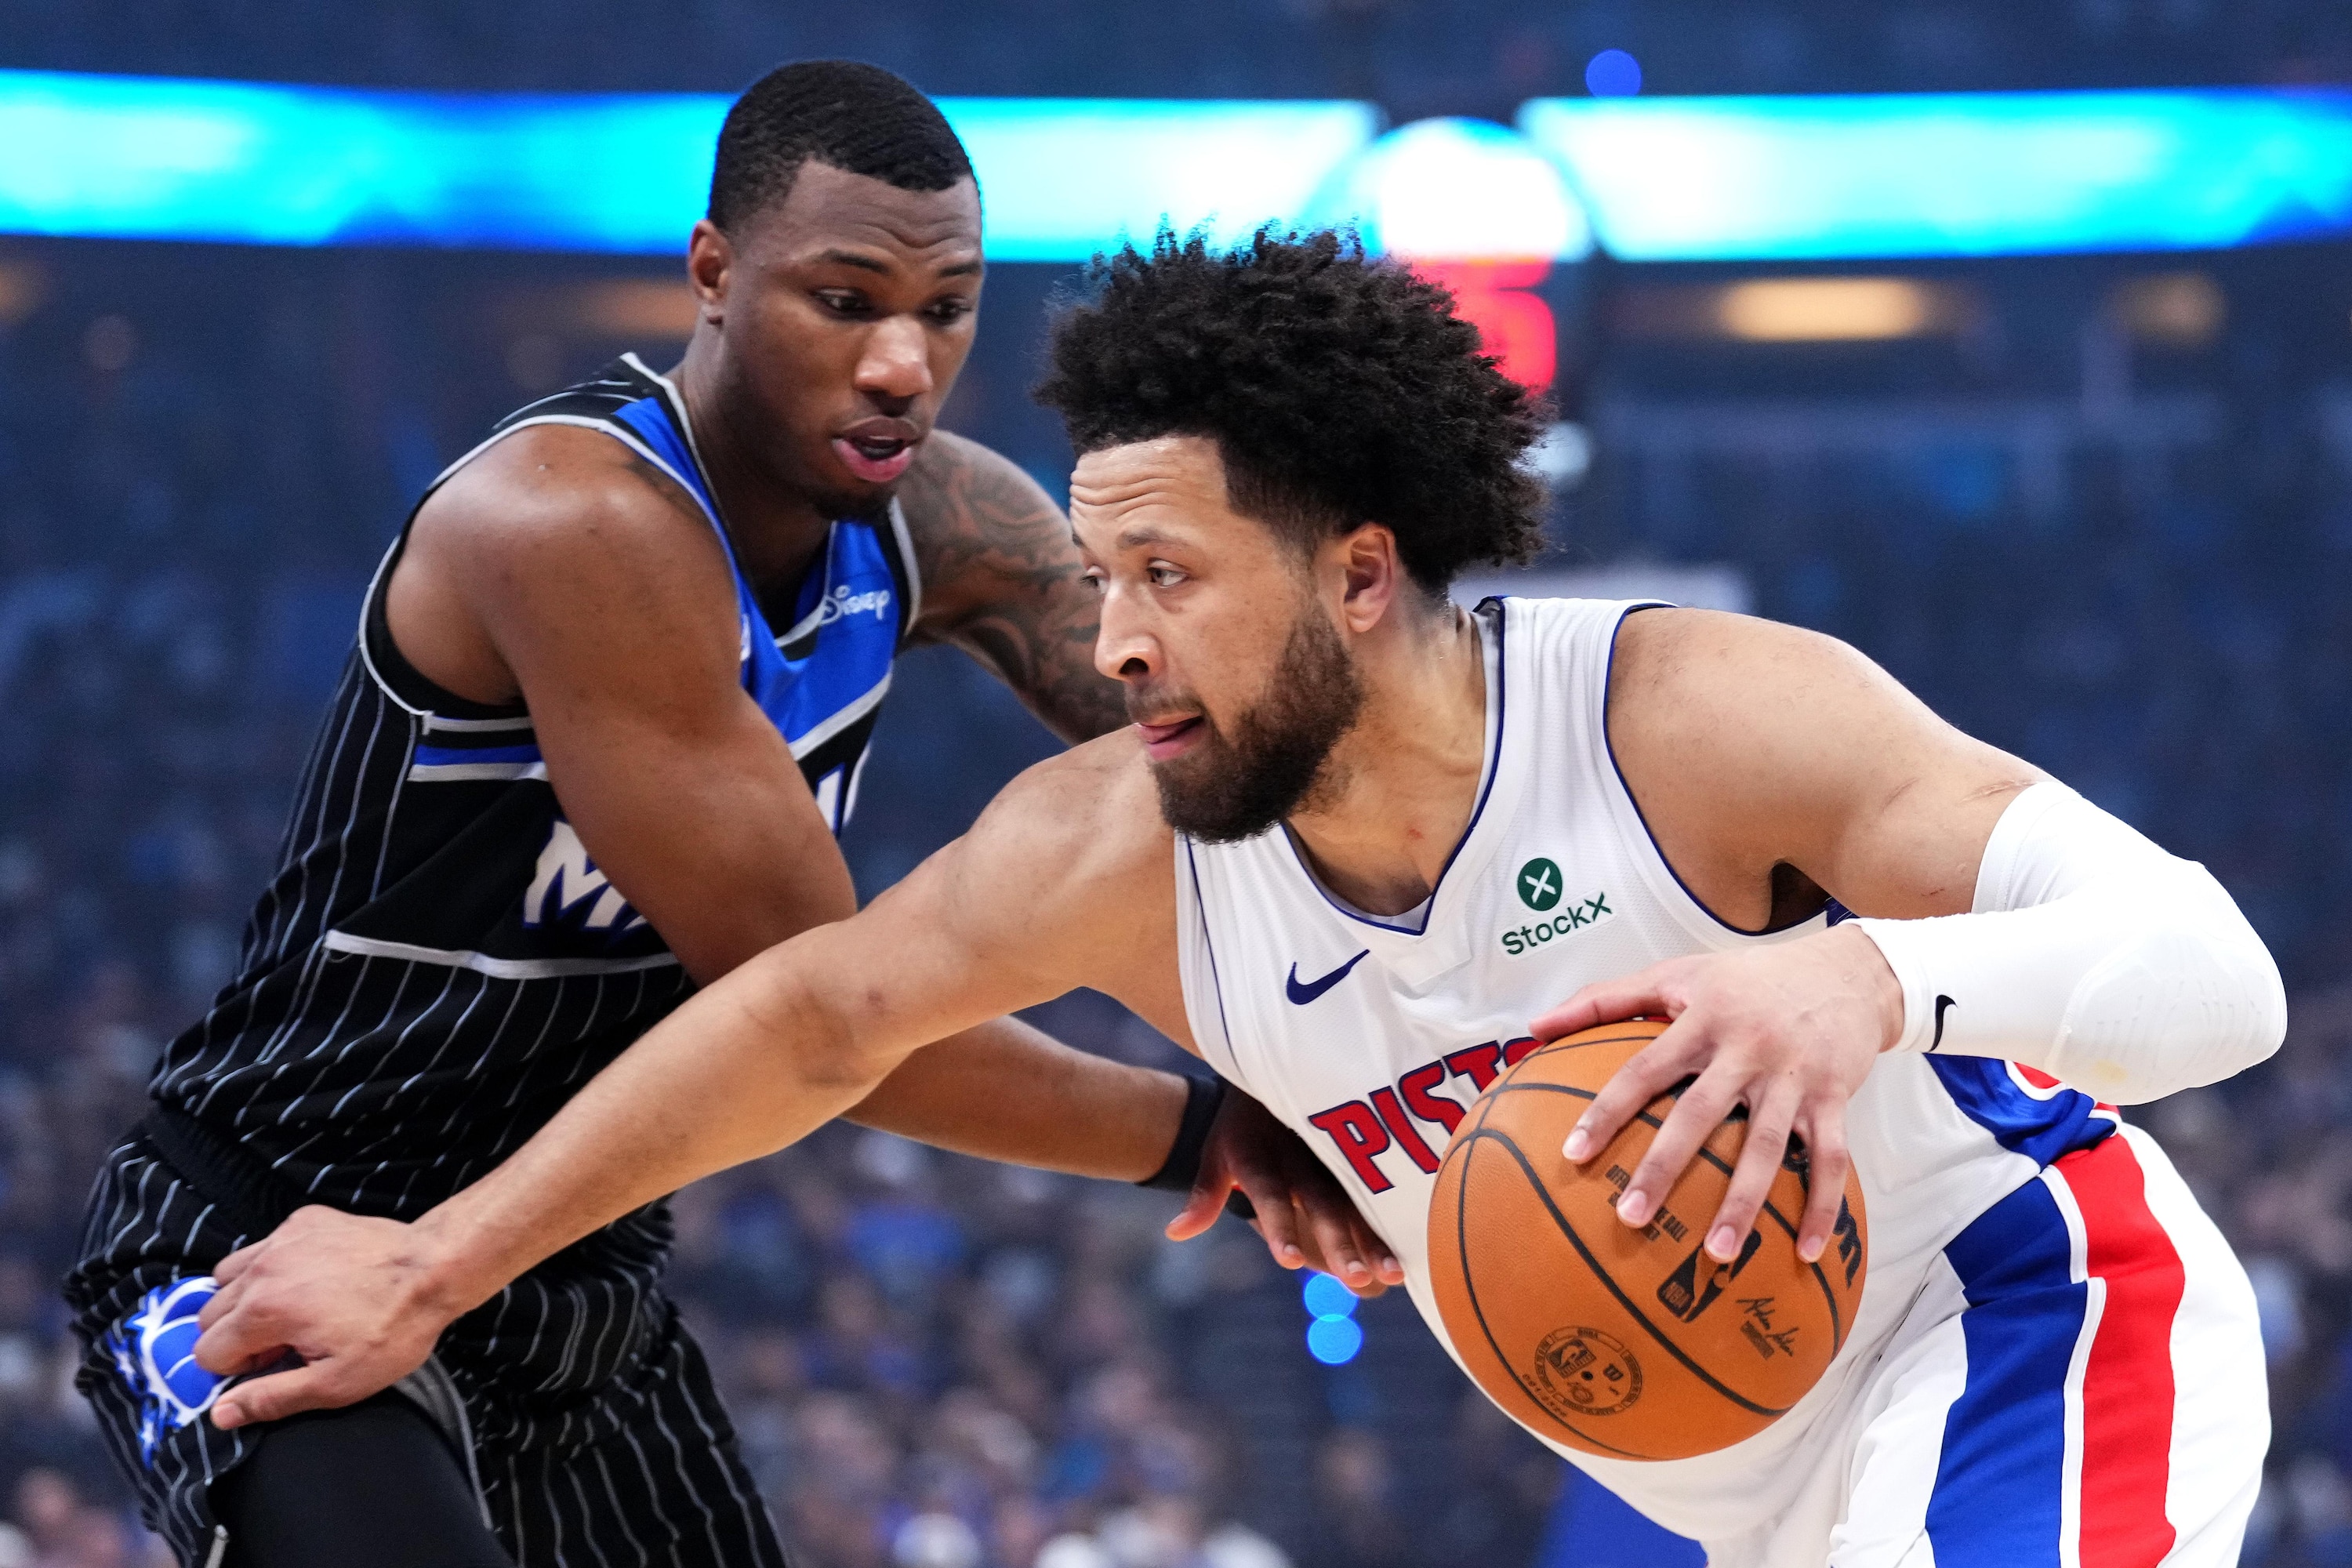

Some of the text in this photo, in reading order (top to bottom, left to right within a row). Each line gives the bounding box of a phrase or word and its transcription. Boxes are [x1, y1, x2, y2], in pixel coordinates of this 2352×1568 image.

[820, 584, 891, 626] Disney
[1501, 891, 1613, 955] StockX
[1308, 1036, 1544, 1195] PIST
[1661, 1280, 1691, 1309] NBA
